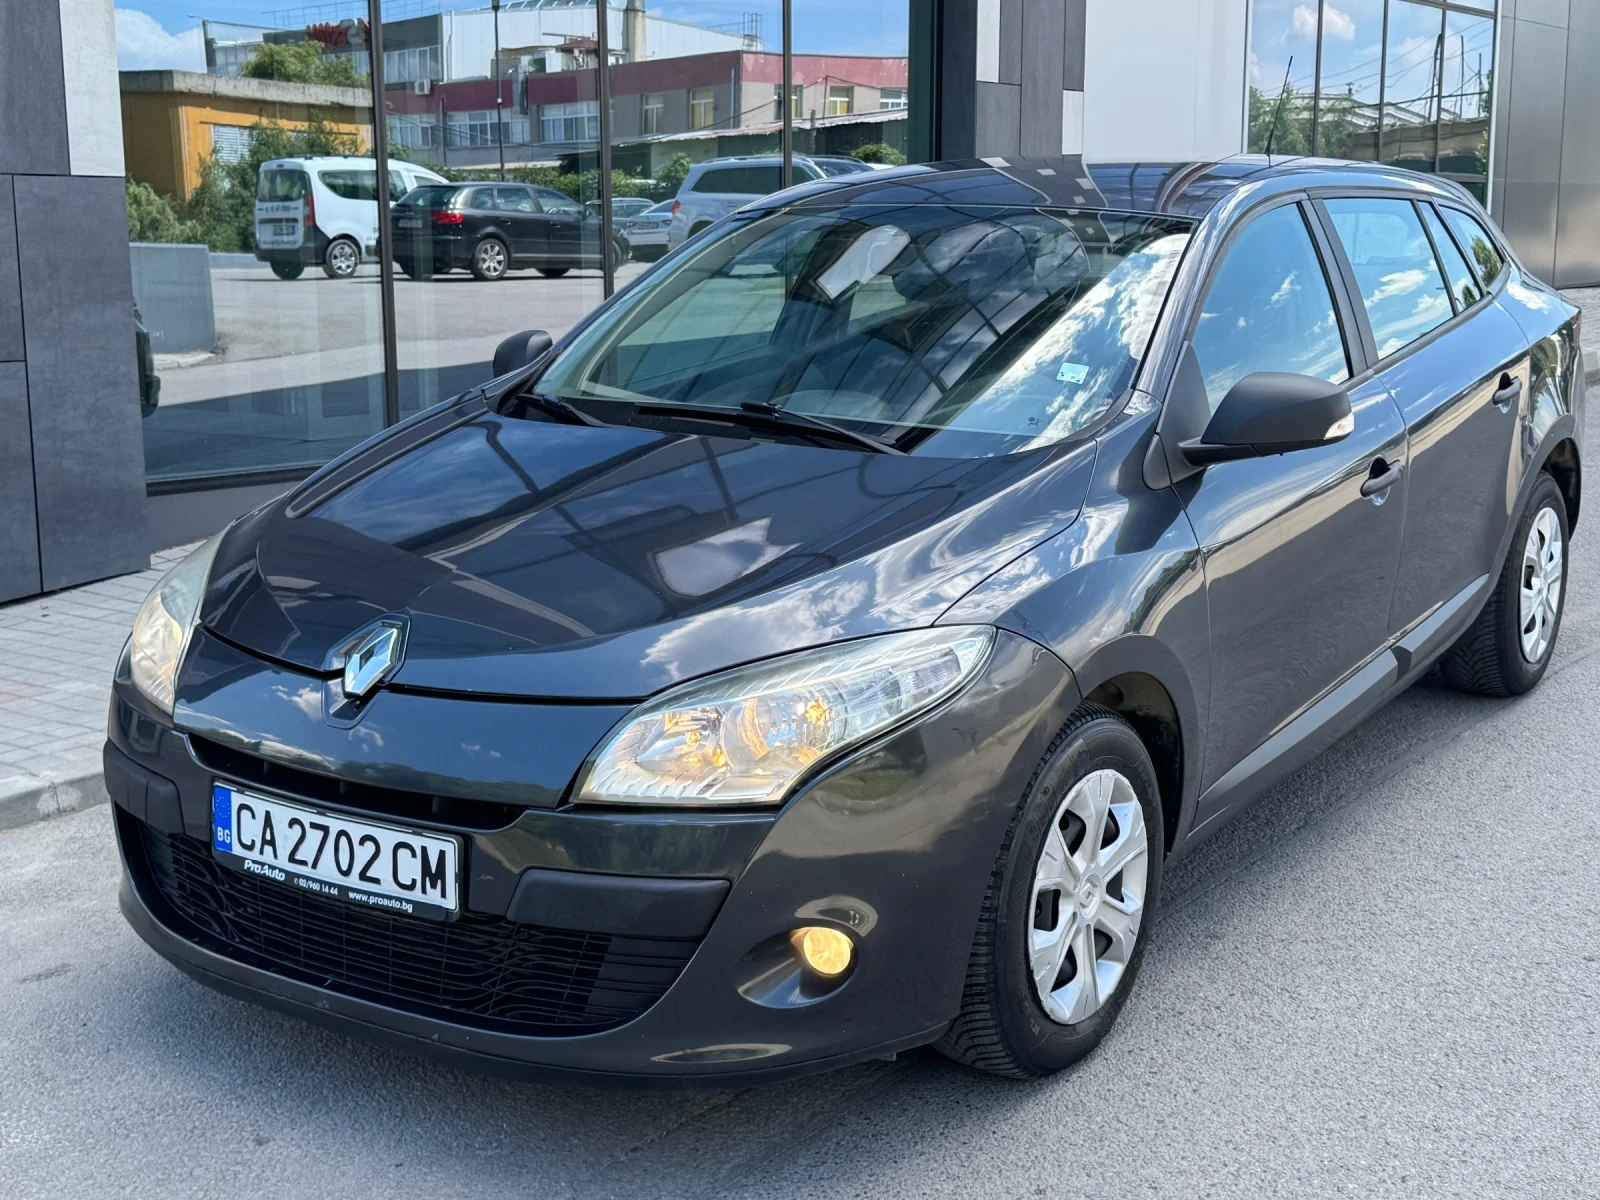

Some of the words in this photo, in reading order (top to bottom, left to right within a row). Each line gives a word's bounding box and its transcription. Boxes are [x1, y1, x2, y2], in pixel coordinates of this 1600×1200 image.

[217, 826, 231, 844] BG
[236, 803, 278, 860] CA
[288, 817, 382, 885] 2702
[392, 841, 447, 899] CM
[244, 859, 286, 882] ProAuto
[321, 883, 330, 893] 14
[329, 886, 338, 896] 44
[348, 890, 413, 912] www.proauto.bg
